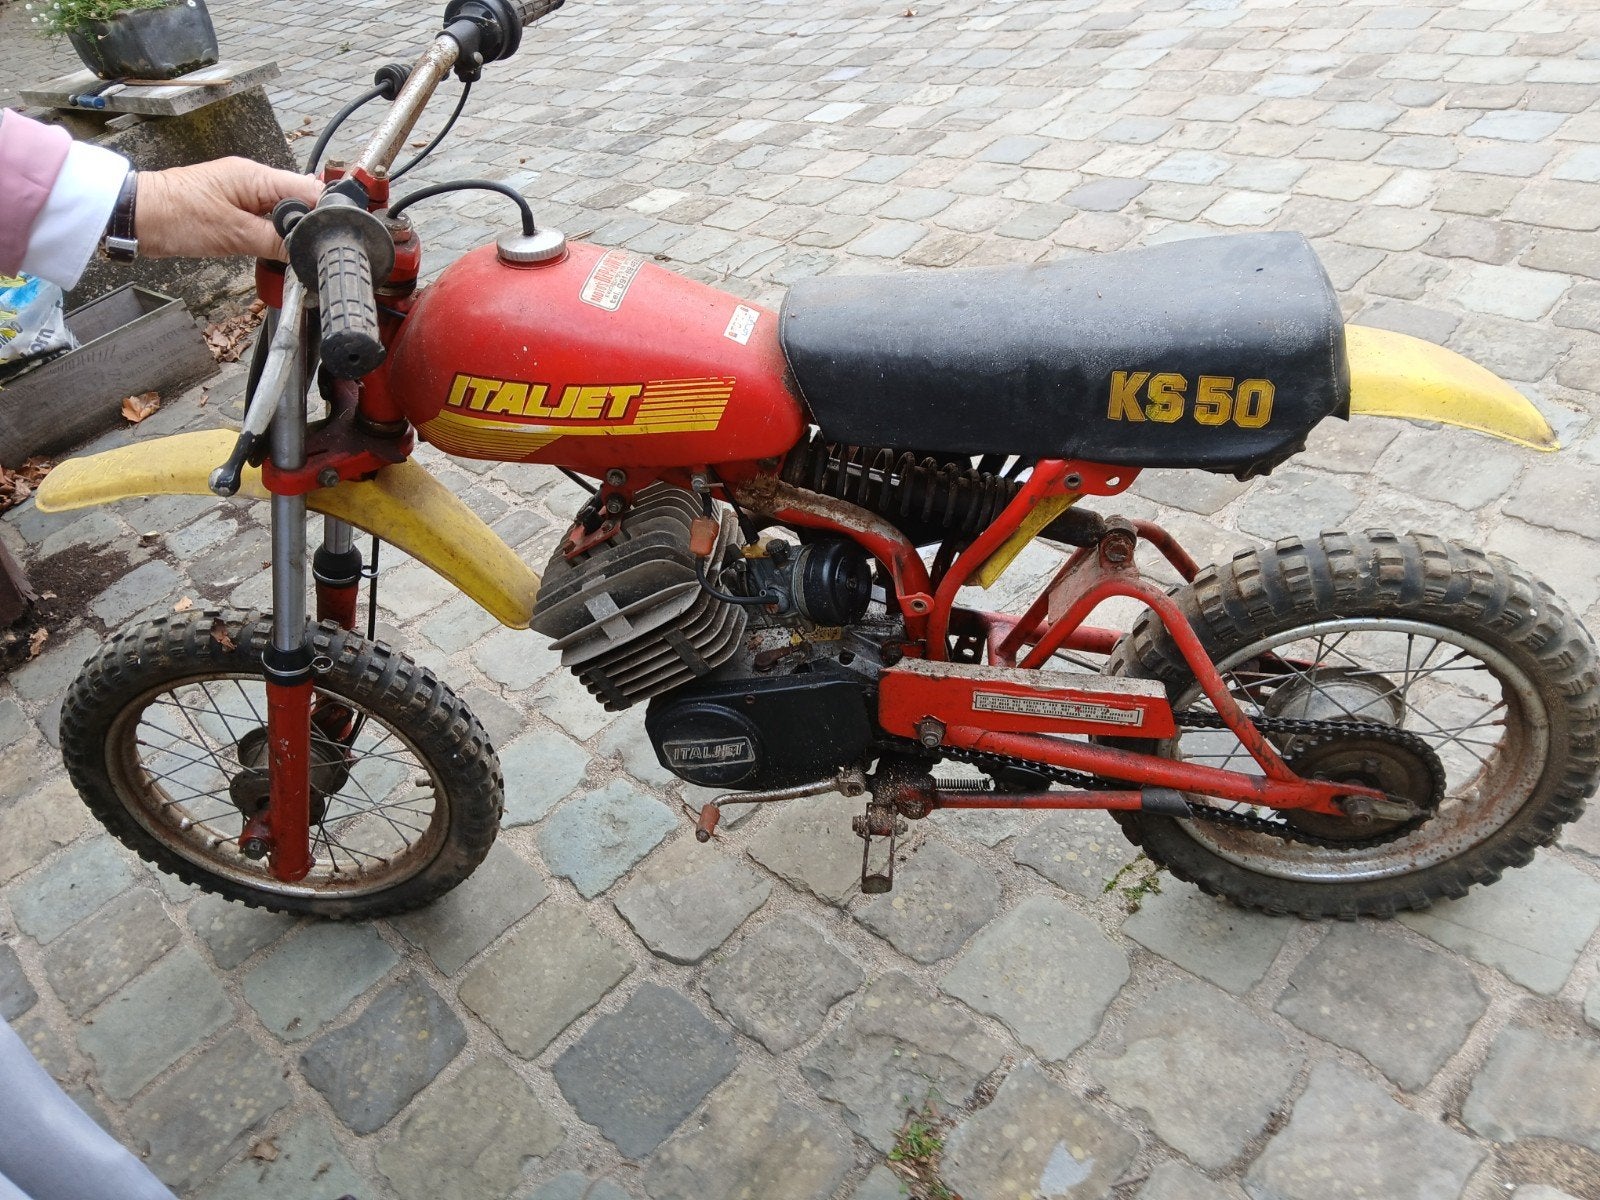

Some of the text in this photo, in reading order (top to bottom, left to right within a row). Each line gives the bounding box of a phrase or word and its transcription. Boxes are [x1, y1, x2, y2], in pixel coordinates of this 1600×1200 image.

[447, 373, 645, 420] ITALJET
[1107, 370, 1276, 428] KS 50
[673, 741, 746, 760] ITALJET
